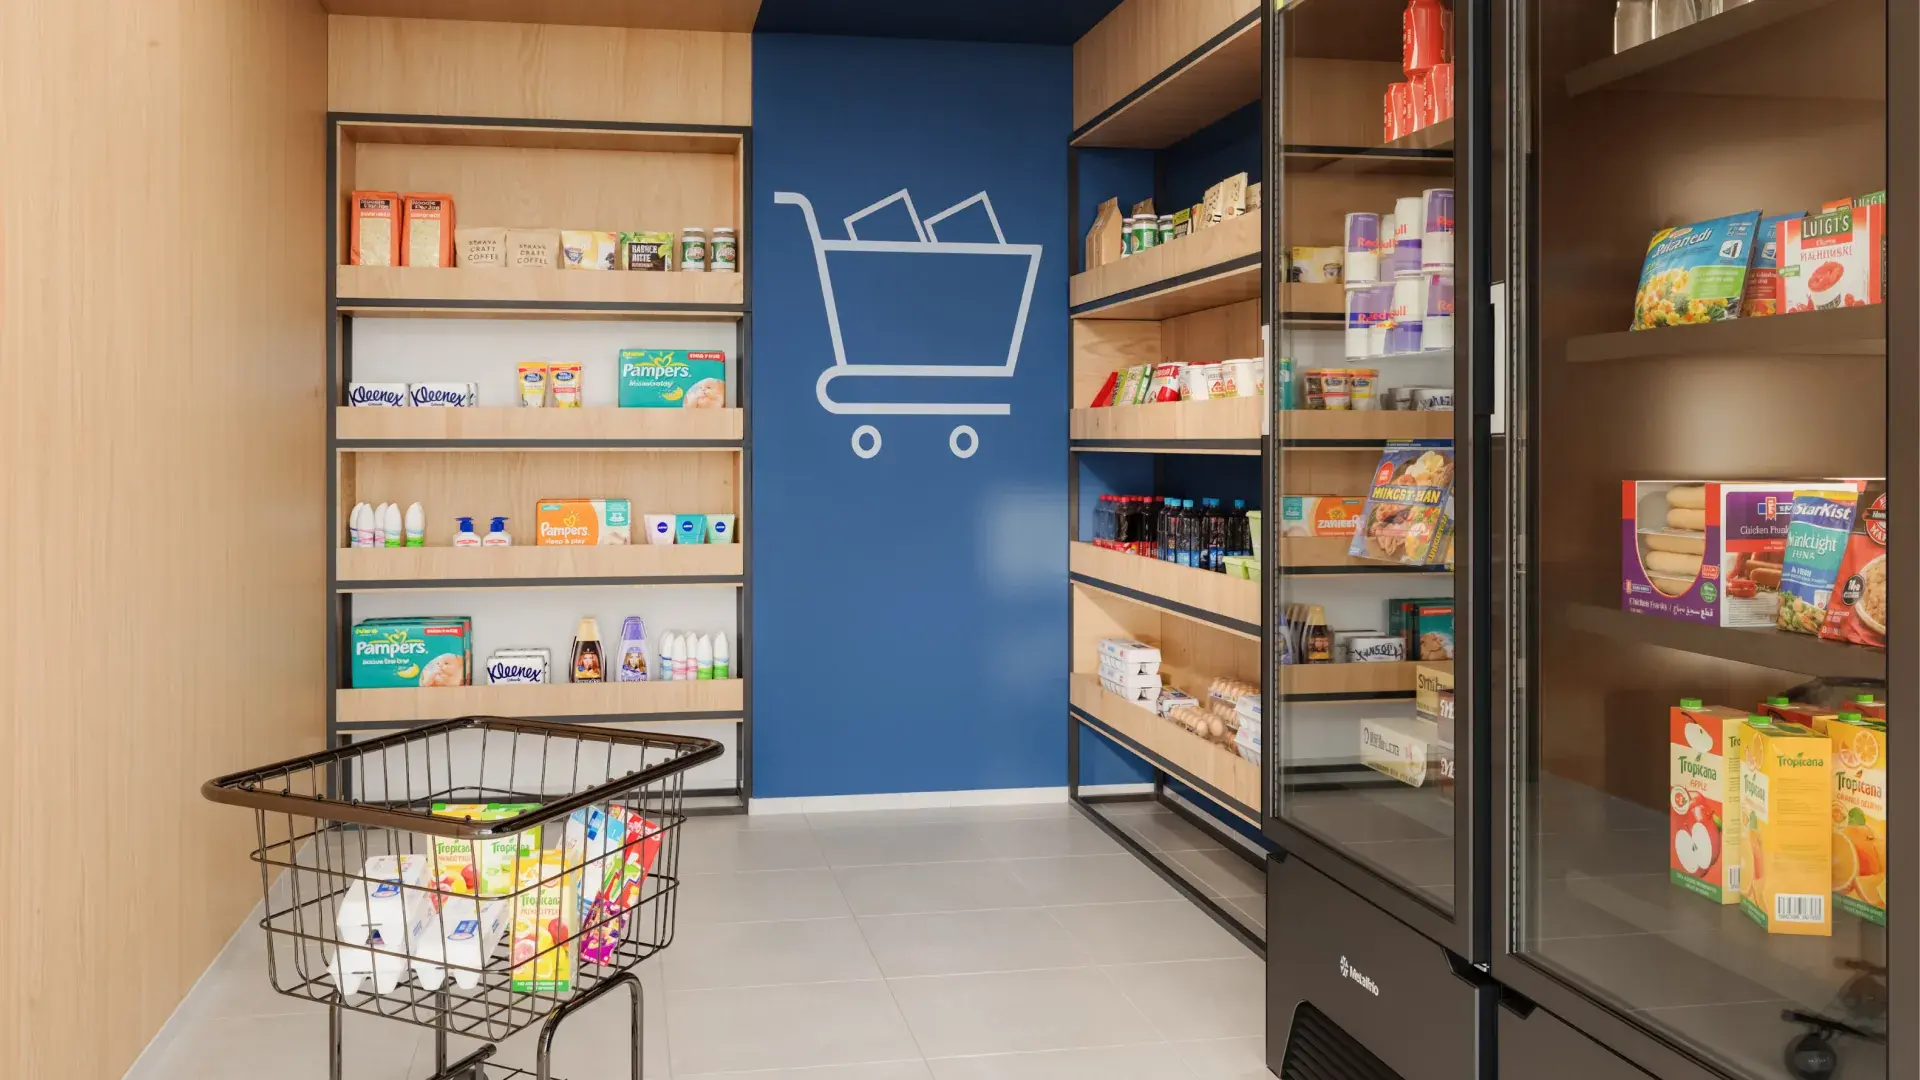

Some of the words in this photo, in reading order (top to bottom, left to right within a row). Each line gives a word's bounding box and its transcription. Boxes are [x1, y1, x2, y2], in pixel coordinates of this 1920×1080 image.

[622, 363, 689, 380] Pampers
[349, 385, 404, 407] Kleenex
[411, 386, 466, 407] Kleenex
[1795, 502, 1852, 520] StarKist
[541, 521, 589, 538] Pampers
[356, 641, 427, 658] Pampers
[487, 661, 541, 683] Kleenex
[1678, 755, 1717, 781] Tropicana
[1777, 755, 1824, 768] Tropicana
[1836, 771, 1882, 799] Tropicana
